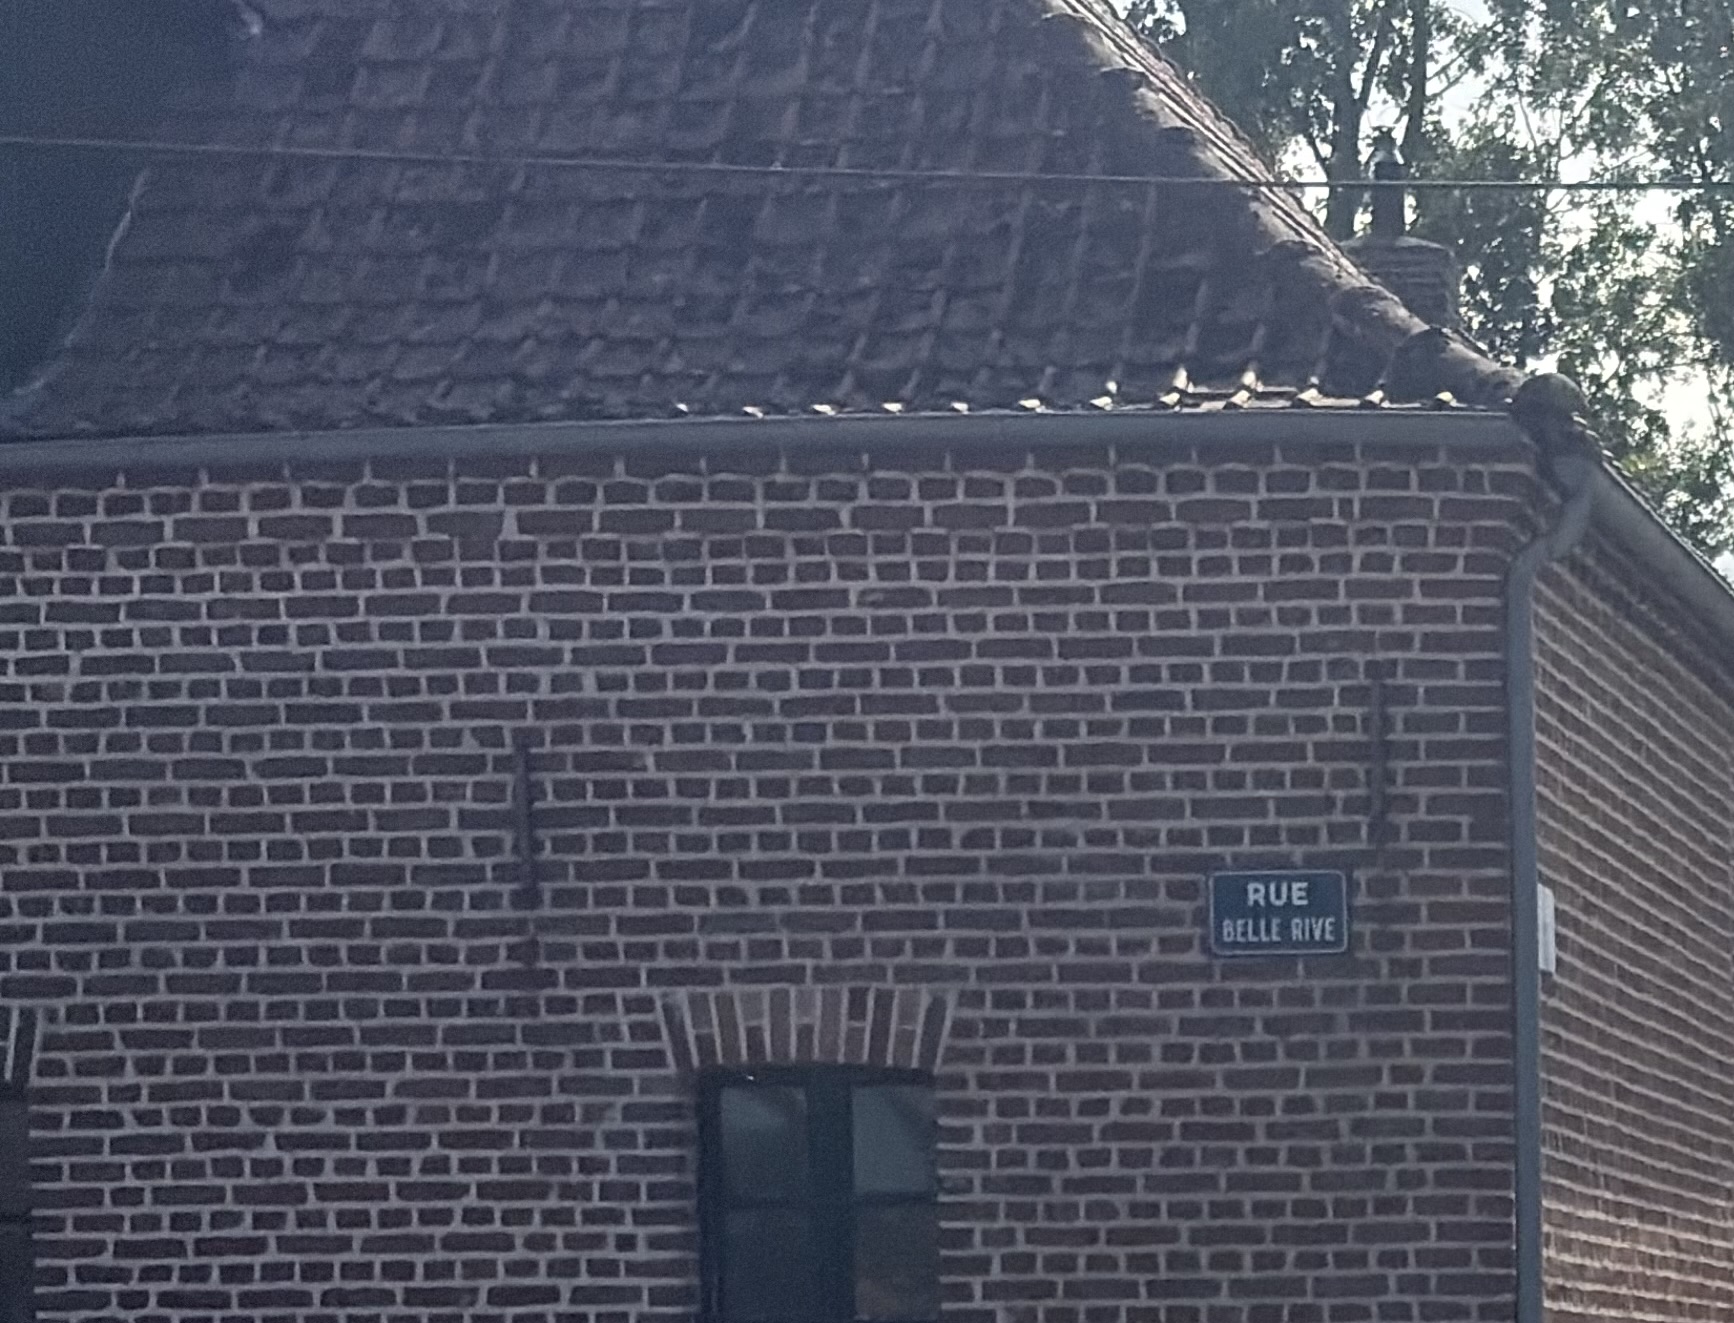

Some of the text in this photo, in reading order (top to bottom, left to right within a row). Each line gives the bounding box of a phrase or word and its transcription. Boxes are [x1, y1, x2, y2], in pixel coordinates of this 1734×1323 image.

[1247, 881, 1309, 907] RUE
[1222, 916, 1336, 942] BELLE RIVE
